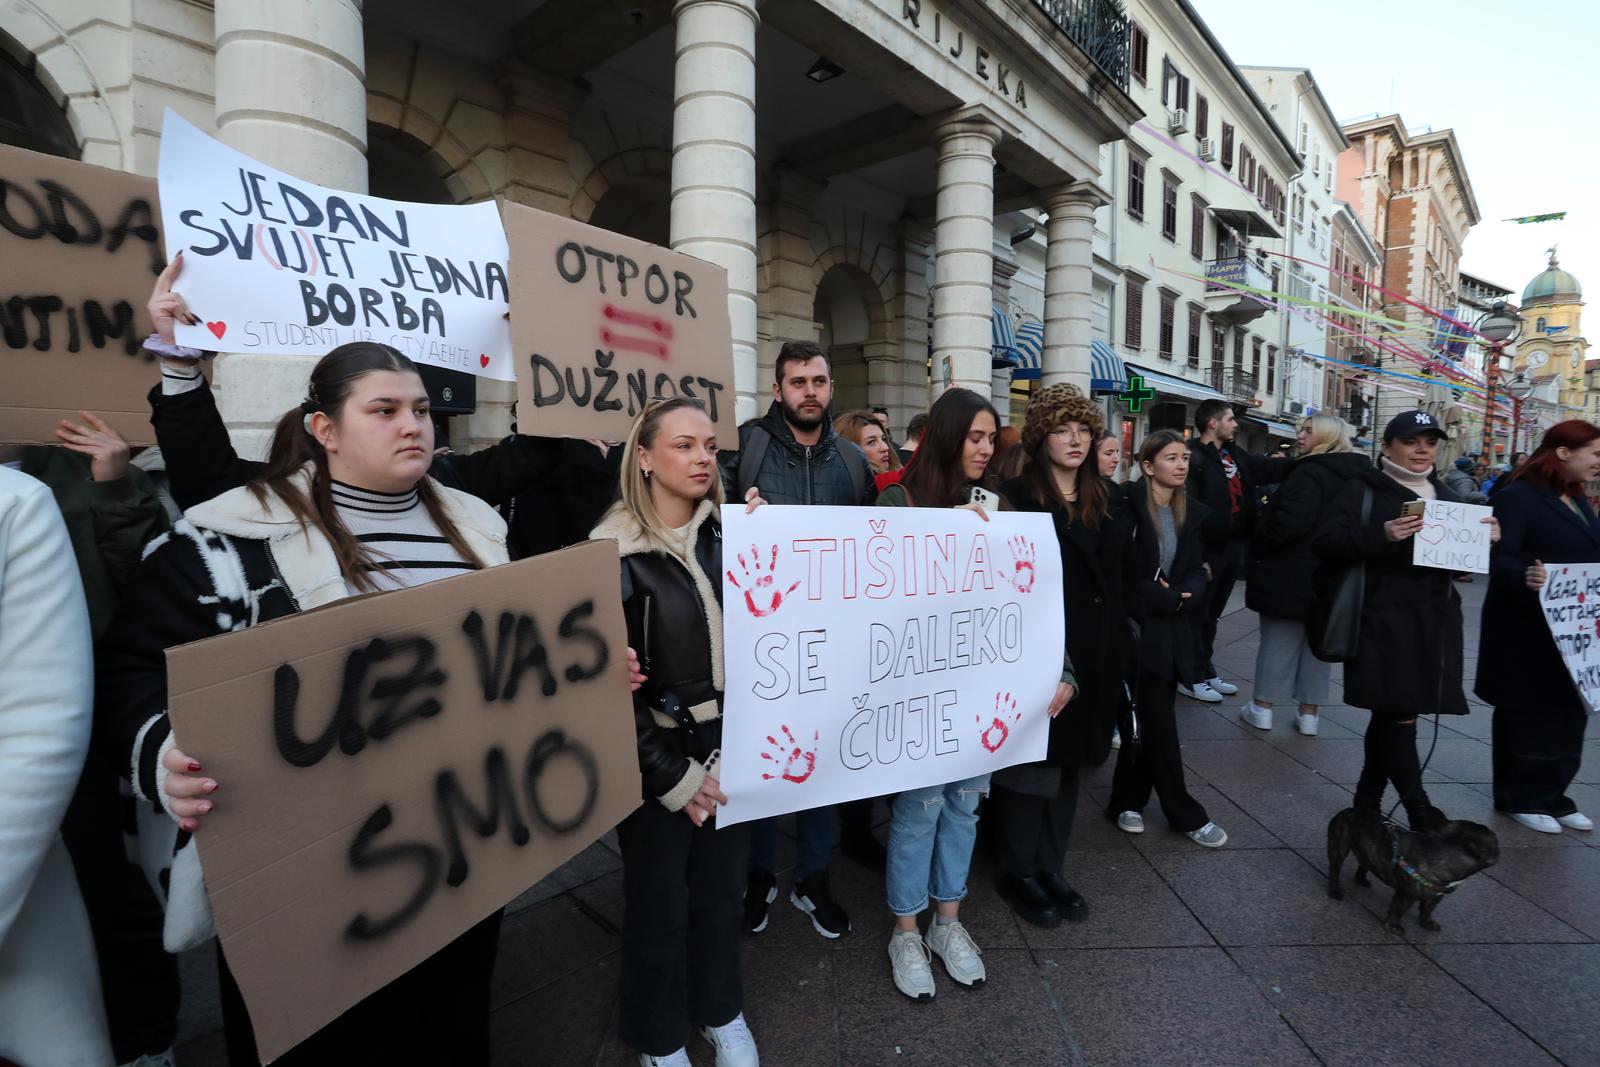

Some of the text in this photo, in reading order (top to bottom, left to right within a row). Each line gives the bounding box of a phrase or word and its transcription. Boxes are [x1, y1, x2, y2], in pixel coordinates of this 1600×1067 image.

[902, 0, 1027, 109] RIJEKA
[222, 168, 409, 248] JEDAN
[380, 250, 509, 304] JEDNA
[556, 241, 698, 319] OTPOR
[1211, 263, 1244, 273] HAPPY
[243, 321, 338, 347] STUDENTI
[298, 279, 445, 337] BORBA
[530, 349, 724, 423] DUŽNOST
[793, 519, 994, 600] TIŠINA
[1446, 528, 1485, 546] NOVI
[274, 600, 610, 768] UZ VAS
[752, 602, 1023, 701] SE DALEKO
[839, 689, 960, 771] ČUJE
[343, 728, 600, 944] SMO
